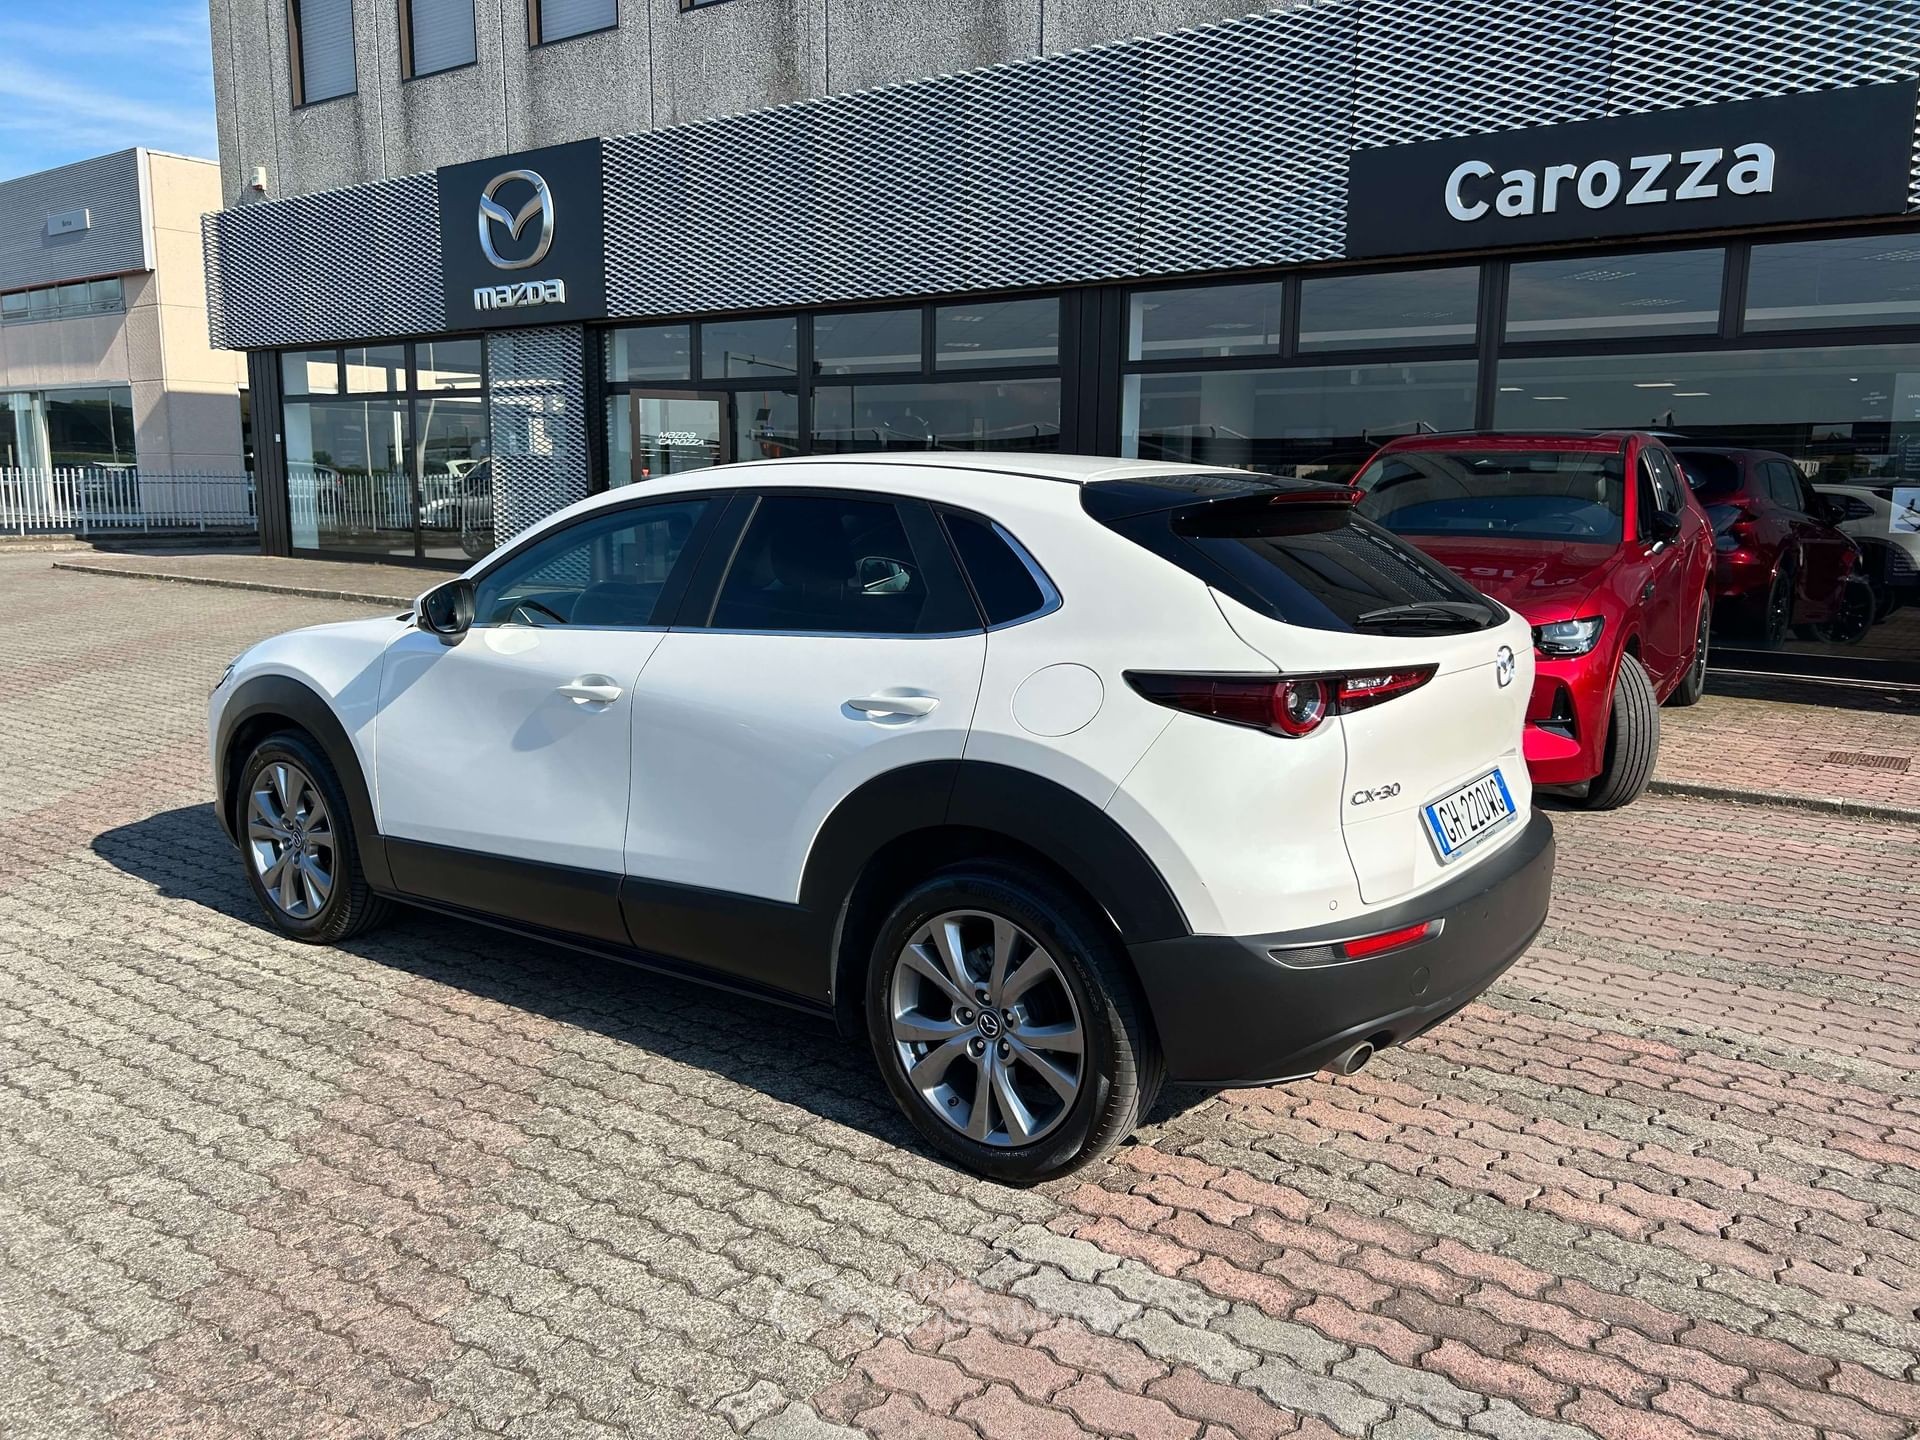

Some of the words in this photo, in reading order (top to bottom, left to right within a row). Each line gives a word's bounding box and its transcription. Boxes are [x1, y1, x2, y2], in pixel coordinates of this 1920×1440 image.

[1444, 142, 1776, 222] Carozza
[1350, 781, 1401, 806] CX-30
[1438, 800, 1468, 843] GH
[1459, 778, 1505, 832] 220WG
